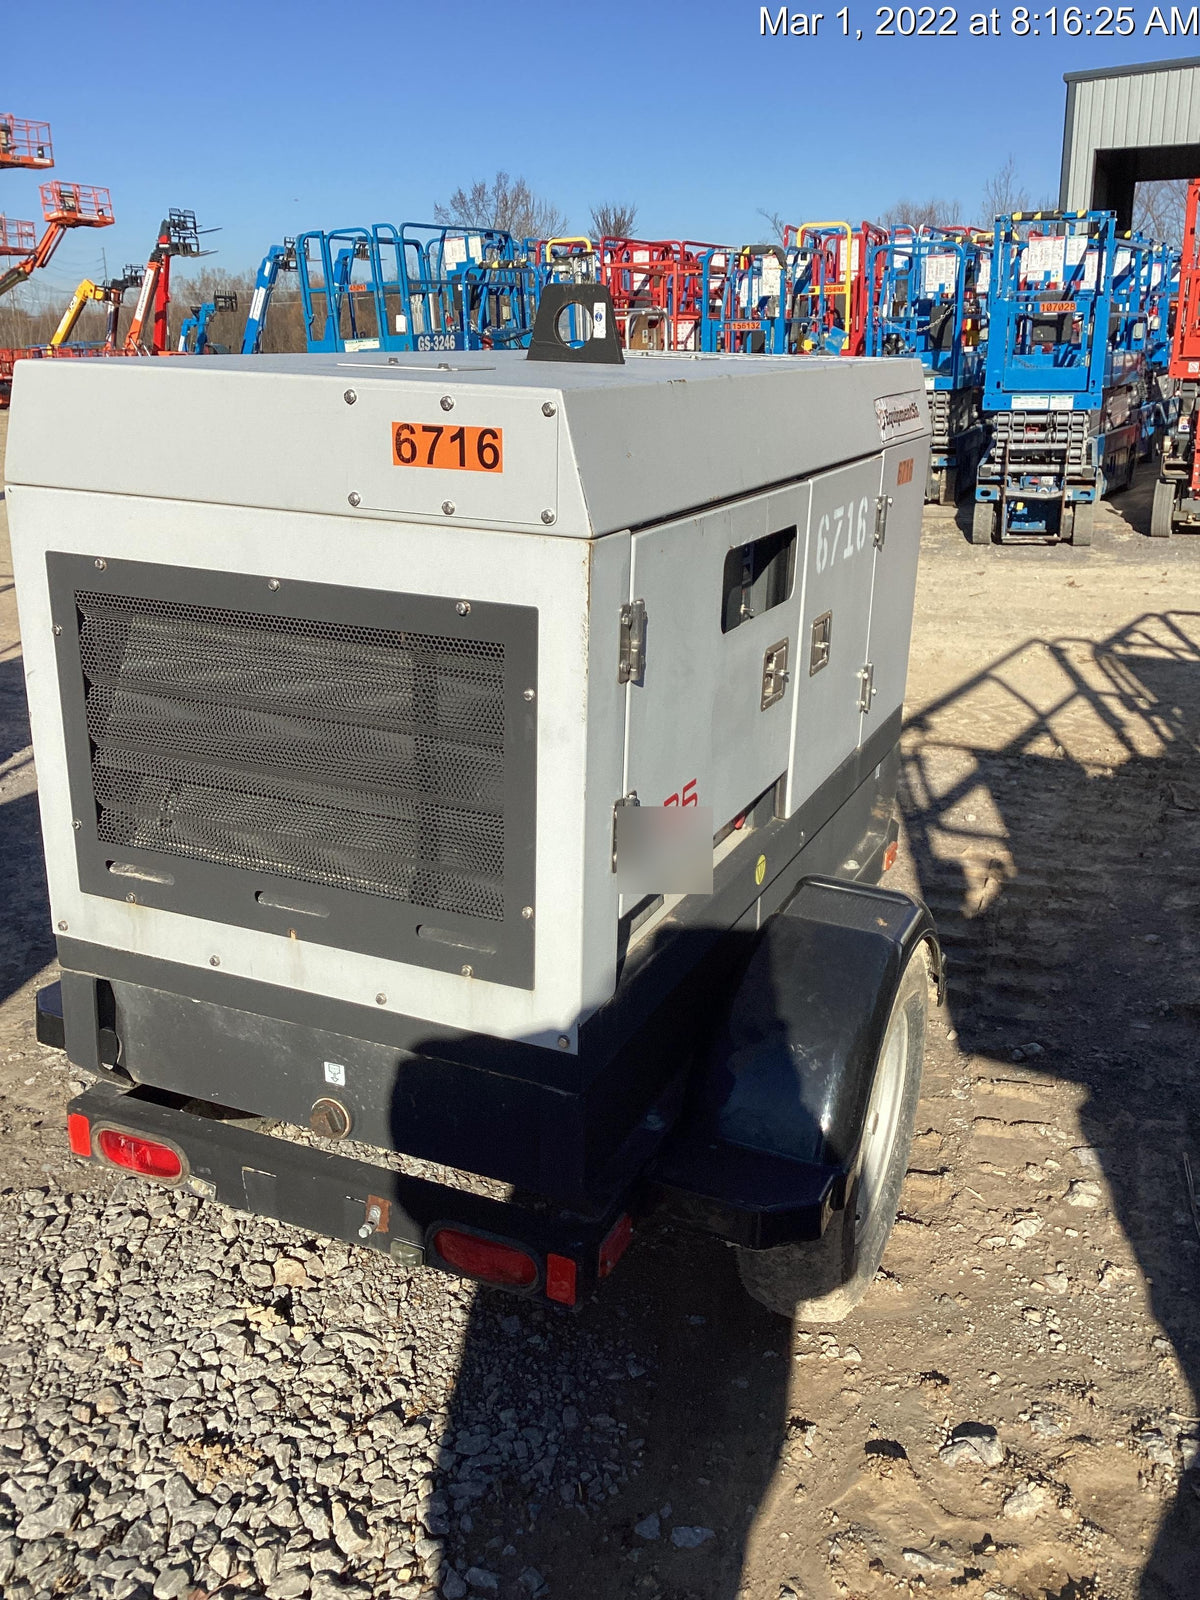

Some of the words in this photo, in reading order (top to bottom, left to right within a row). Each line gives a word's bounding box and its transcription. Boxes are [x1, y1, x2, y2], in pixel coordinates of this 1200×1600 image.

[417, 334, 456, 351] GS-3246
[395, 423, 500, 470] 6716
[816, 495, 868, 575] 6716
